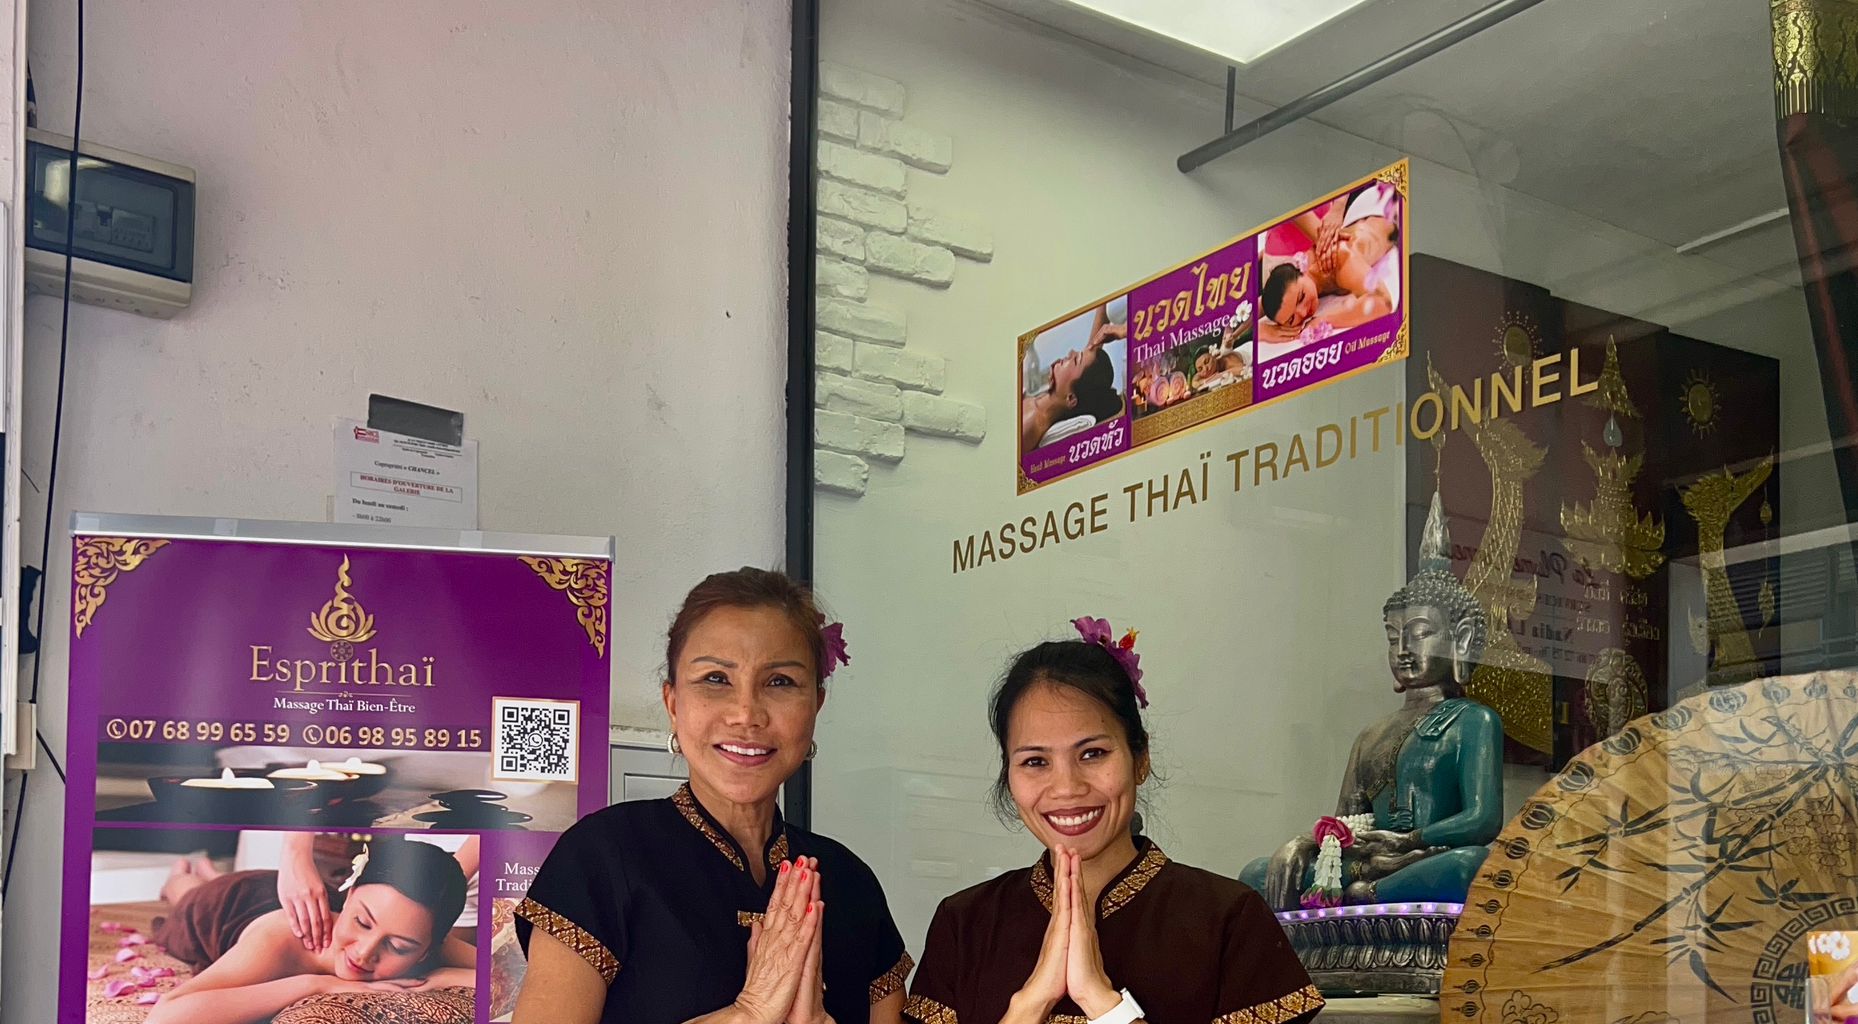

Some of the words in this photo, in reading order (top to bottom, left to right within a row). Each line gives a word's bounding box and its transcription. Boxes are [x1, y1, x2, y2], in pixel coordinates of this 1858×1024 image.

[1134, 262, 1252, 341] นวดไทย
[1134, 336, 1166, 363] Thai
[1170, 314, 1230, 349] Massage
[1345, 339, 1357, 354] Oil
[1357, 331, 1390, 350] Massage
[1262, 341, 1344, 389] นวดออย
[1069, 420, 1124, 463] นวดหัว
[408, 465, 436, 475] CHANCEL
[953, 493, 1108, 573] MASSAGE
[1123, 451, 1211, 522] THAÏ
[1226, 348, 1598, 492] TRADITIONNEL
[360, 474, 392, 484] HORAIRES
[392, 479, 435, 491] D'OUVERTURE
[445, 486, 454, 494] LA
[394, 486, 420, 496] GALERIE
[249, 645, 436, 692] Esprithaï
[273, 697, 324, 714] Massage
[326, 698, 353, 711] Thaï
[356, 697, 416, 713] Bien-Être
[129, 720, 156, 739] 07
[162, 721, 190, 740] 68
[196, 722, 224, 741] 99
[230, 723, 257, 742] 65
[263, 724, 290, 742] 59
[325, 726, 352, 745] 06
[358, 727, 385, 746] 98
[391, 728, 417, 747] 95
[424, 729, 450, 747] 89
[457, 729, 482, 748] 15
[504, 862, 541, 876] Mass
[495, 878, 532, 892] Tradi
